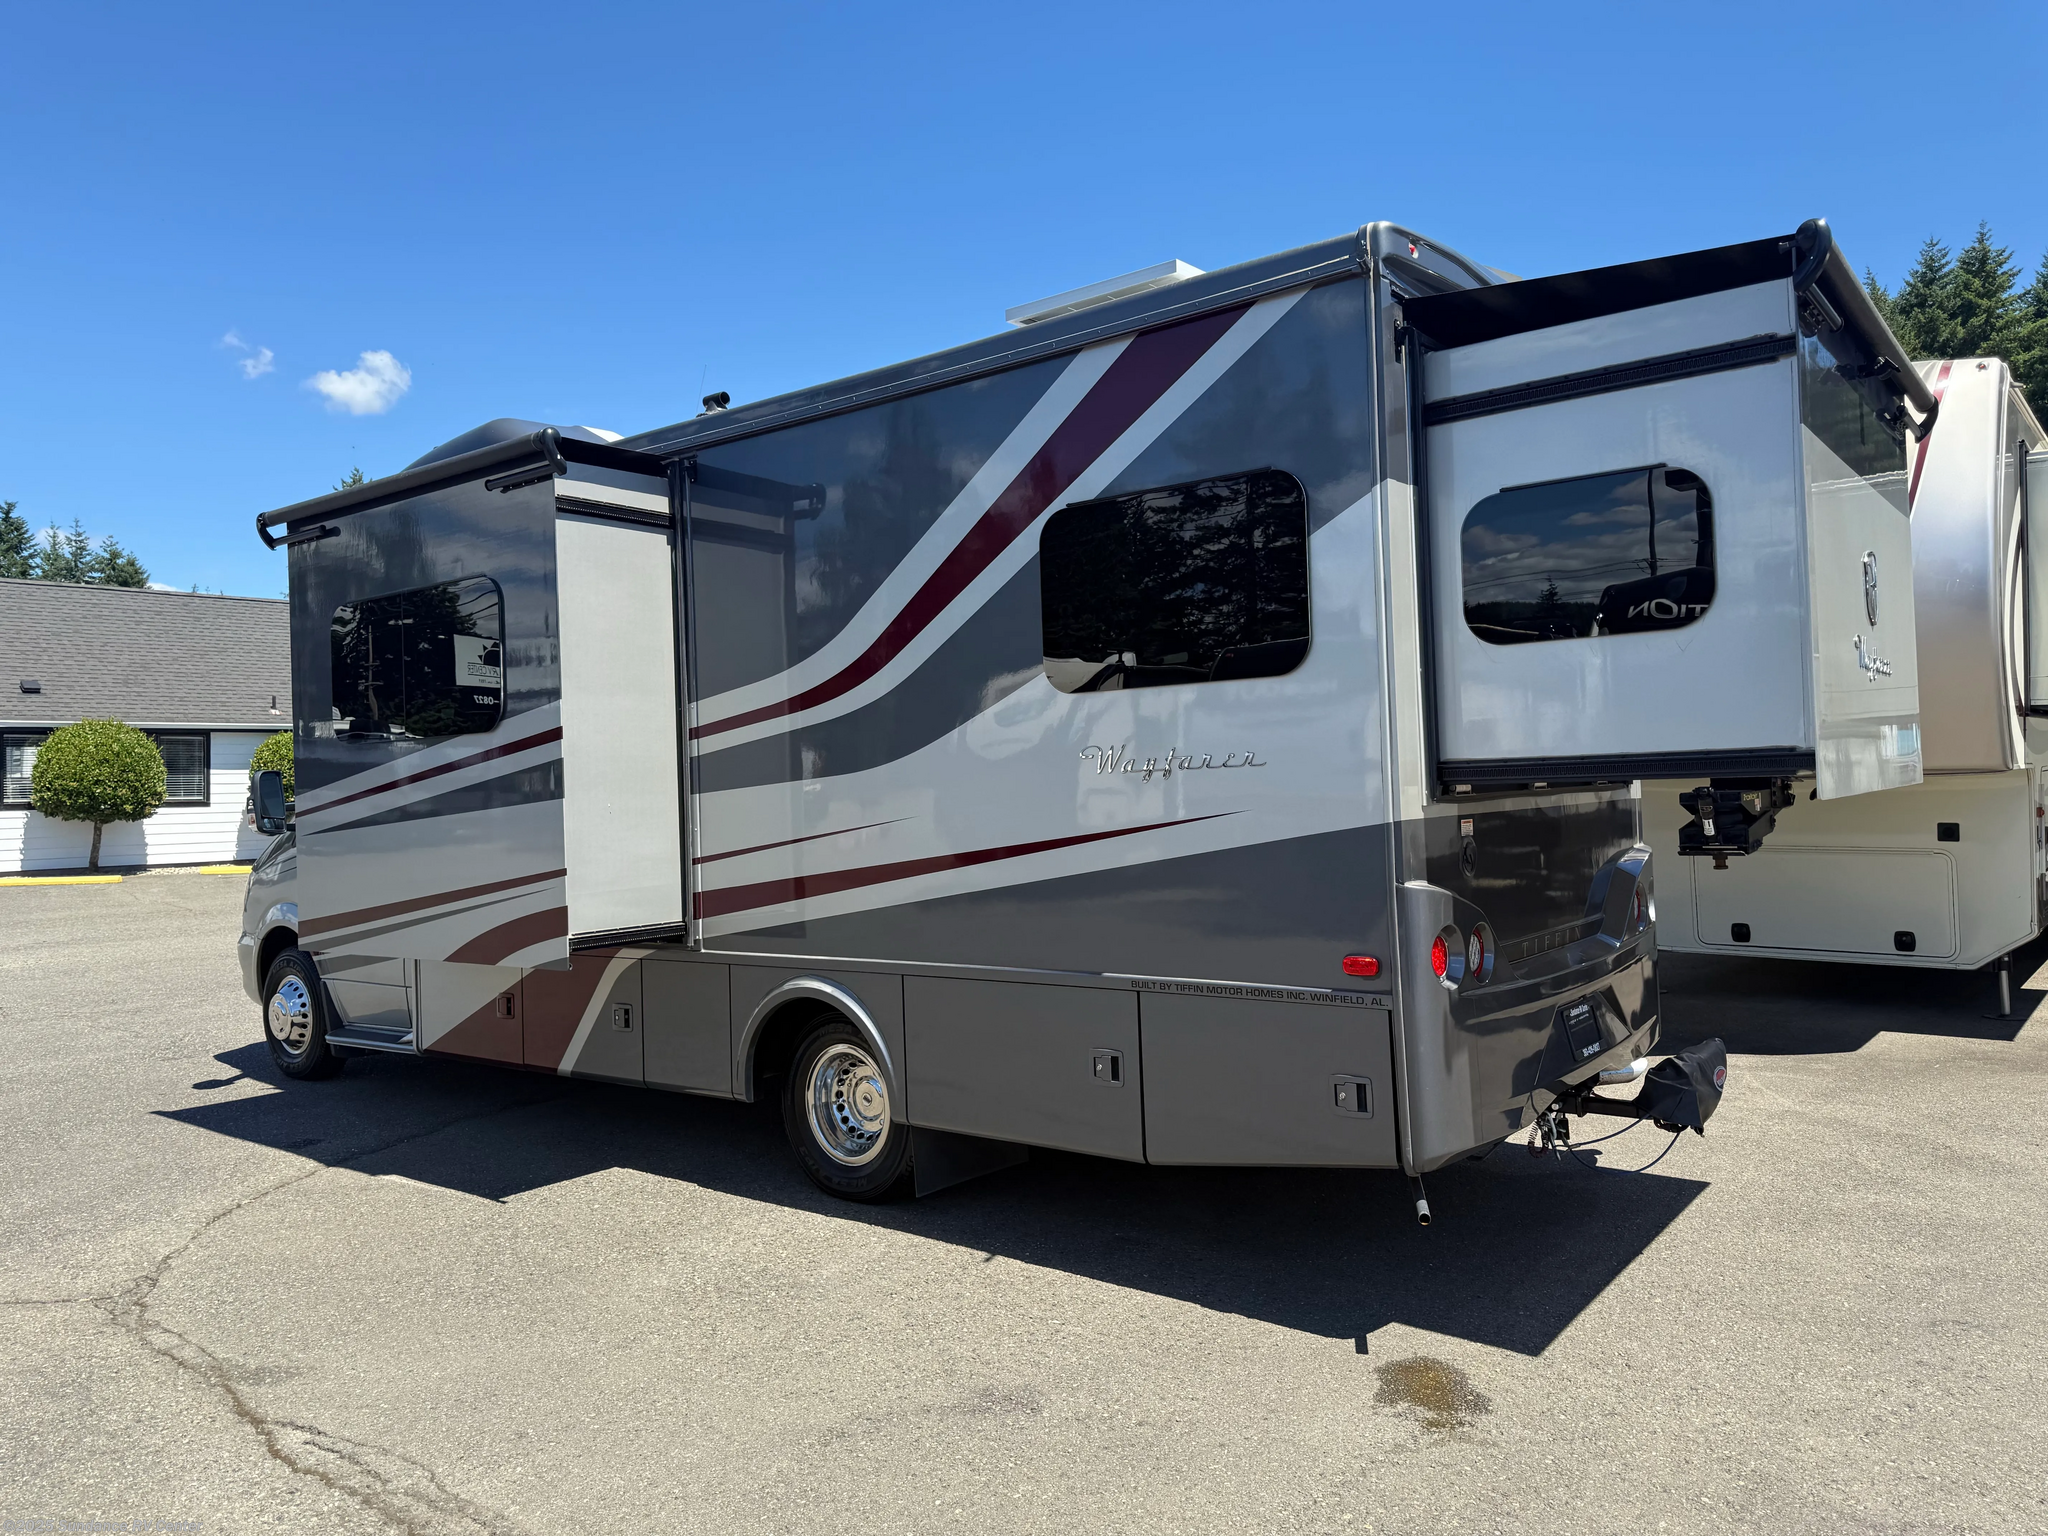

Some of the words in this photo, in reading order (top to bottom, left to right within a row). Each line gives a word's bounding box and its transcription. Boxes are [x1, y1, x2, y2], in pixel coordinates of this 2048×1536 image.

[1080, 744, 1267, 783] Wayfarer
[1522, 926, 1582, 957] TIFFIN
[1131, 980, 1157, 990] BUILT
[1160, 982, 1172, 991] BY
[1174, 983, 1204, 993] TIFFIN
[1206, 985, 1243, 996] MOTOR
[1245, 988, 1284, 999] HOMES
[1286, 991, 1308, 1001] INC.
[1310, 992, 1368, 1006] WINFIELD,
[1370, 997, 1389, 1007] AL.
